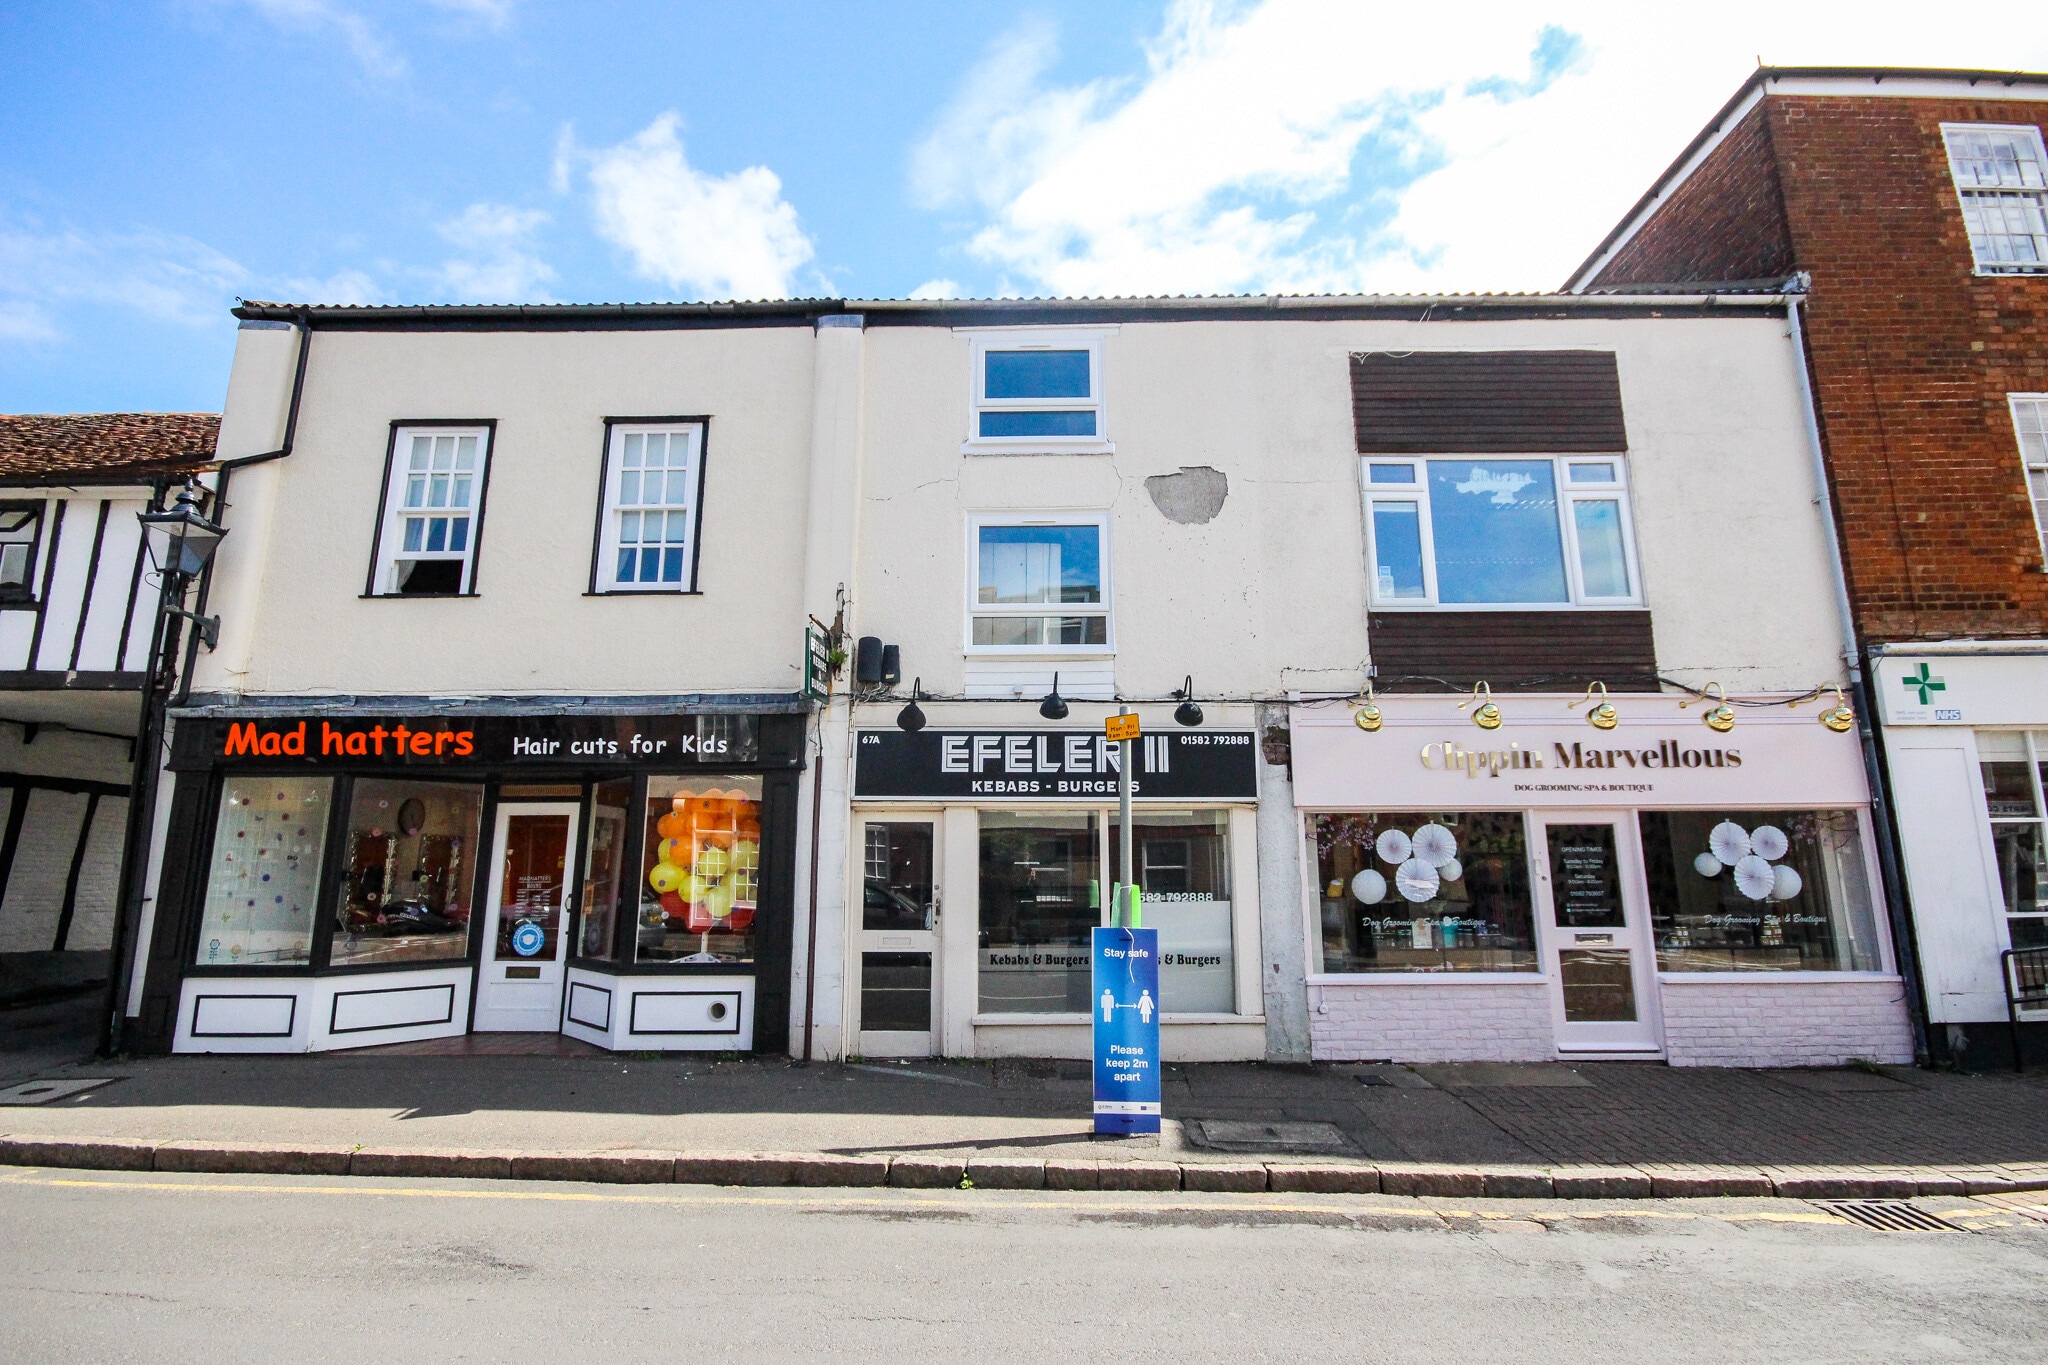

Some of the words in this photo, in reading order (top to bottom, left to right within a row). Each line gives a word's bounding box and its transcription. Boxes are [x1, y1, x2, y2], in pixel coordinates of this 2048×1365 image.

[1936, 710, 1960, 720] NHS
[224, 721, 306, 756] Mad
[322, 721, 474, 756] hatters
[862, 736, 880, 744] 67A
[1180, 736, 1210, 745] 01582
[1213, 736, 1250, 745] 792888
[513, 736, 560, 756] Hair
[570, 737, 618, 754] cuts
[630, 734, 667, 754] for
[682, 734, 728, 754] Kids
[942, 736, 1120, 772] EFELER
[1144, 736, 1170, 772] II
[1420, 741, 1544, 778] Clippin
[1554, 740, 1742, 769] Marvellous
[972, 780, 1040, 792] KEBABS
[1058, 780, 1140, 792] BURGES
[1514, 784, 1534, 792] DOG
[1534, 784, 1583, 792] GROOMING
[1584, 784, 1600, 792] SPA
[1601, 784, 1608, 792] &
[1608, 784, 1654, 793] BOUTIQUE
[1362, 916, 1380, 929] Dog
[1452, 916, 1486, 928] Boutique
[1704, 914, 1721, 926] Dog
[1724, 914, 1760, 926] Grooming
[1785, 913, 1790, 922] &
[1793, 913, 1827, 926] Boutique
[1104, 948, 1126, 959] Stay
[1127, 948, 1149, 958] safe
[990, 954, 1029, 966] Kebabs
[1033, 954, 1042, 966] &
[1045, 954, 1089, 968] Burgers
[1164, 954, 1174, 965] &
[1177, 954, 1220, 967] Burgers
[1110, 1045, 1144, 1055] Please
[1106, 1058, 1130, 1069] keep
[1132, 1058, 1148, 1068] 2m
[1114, 1074, 1141, 1082] apart
